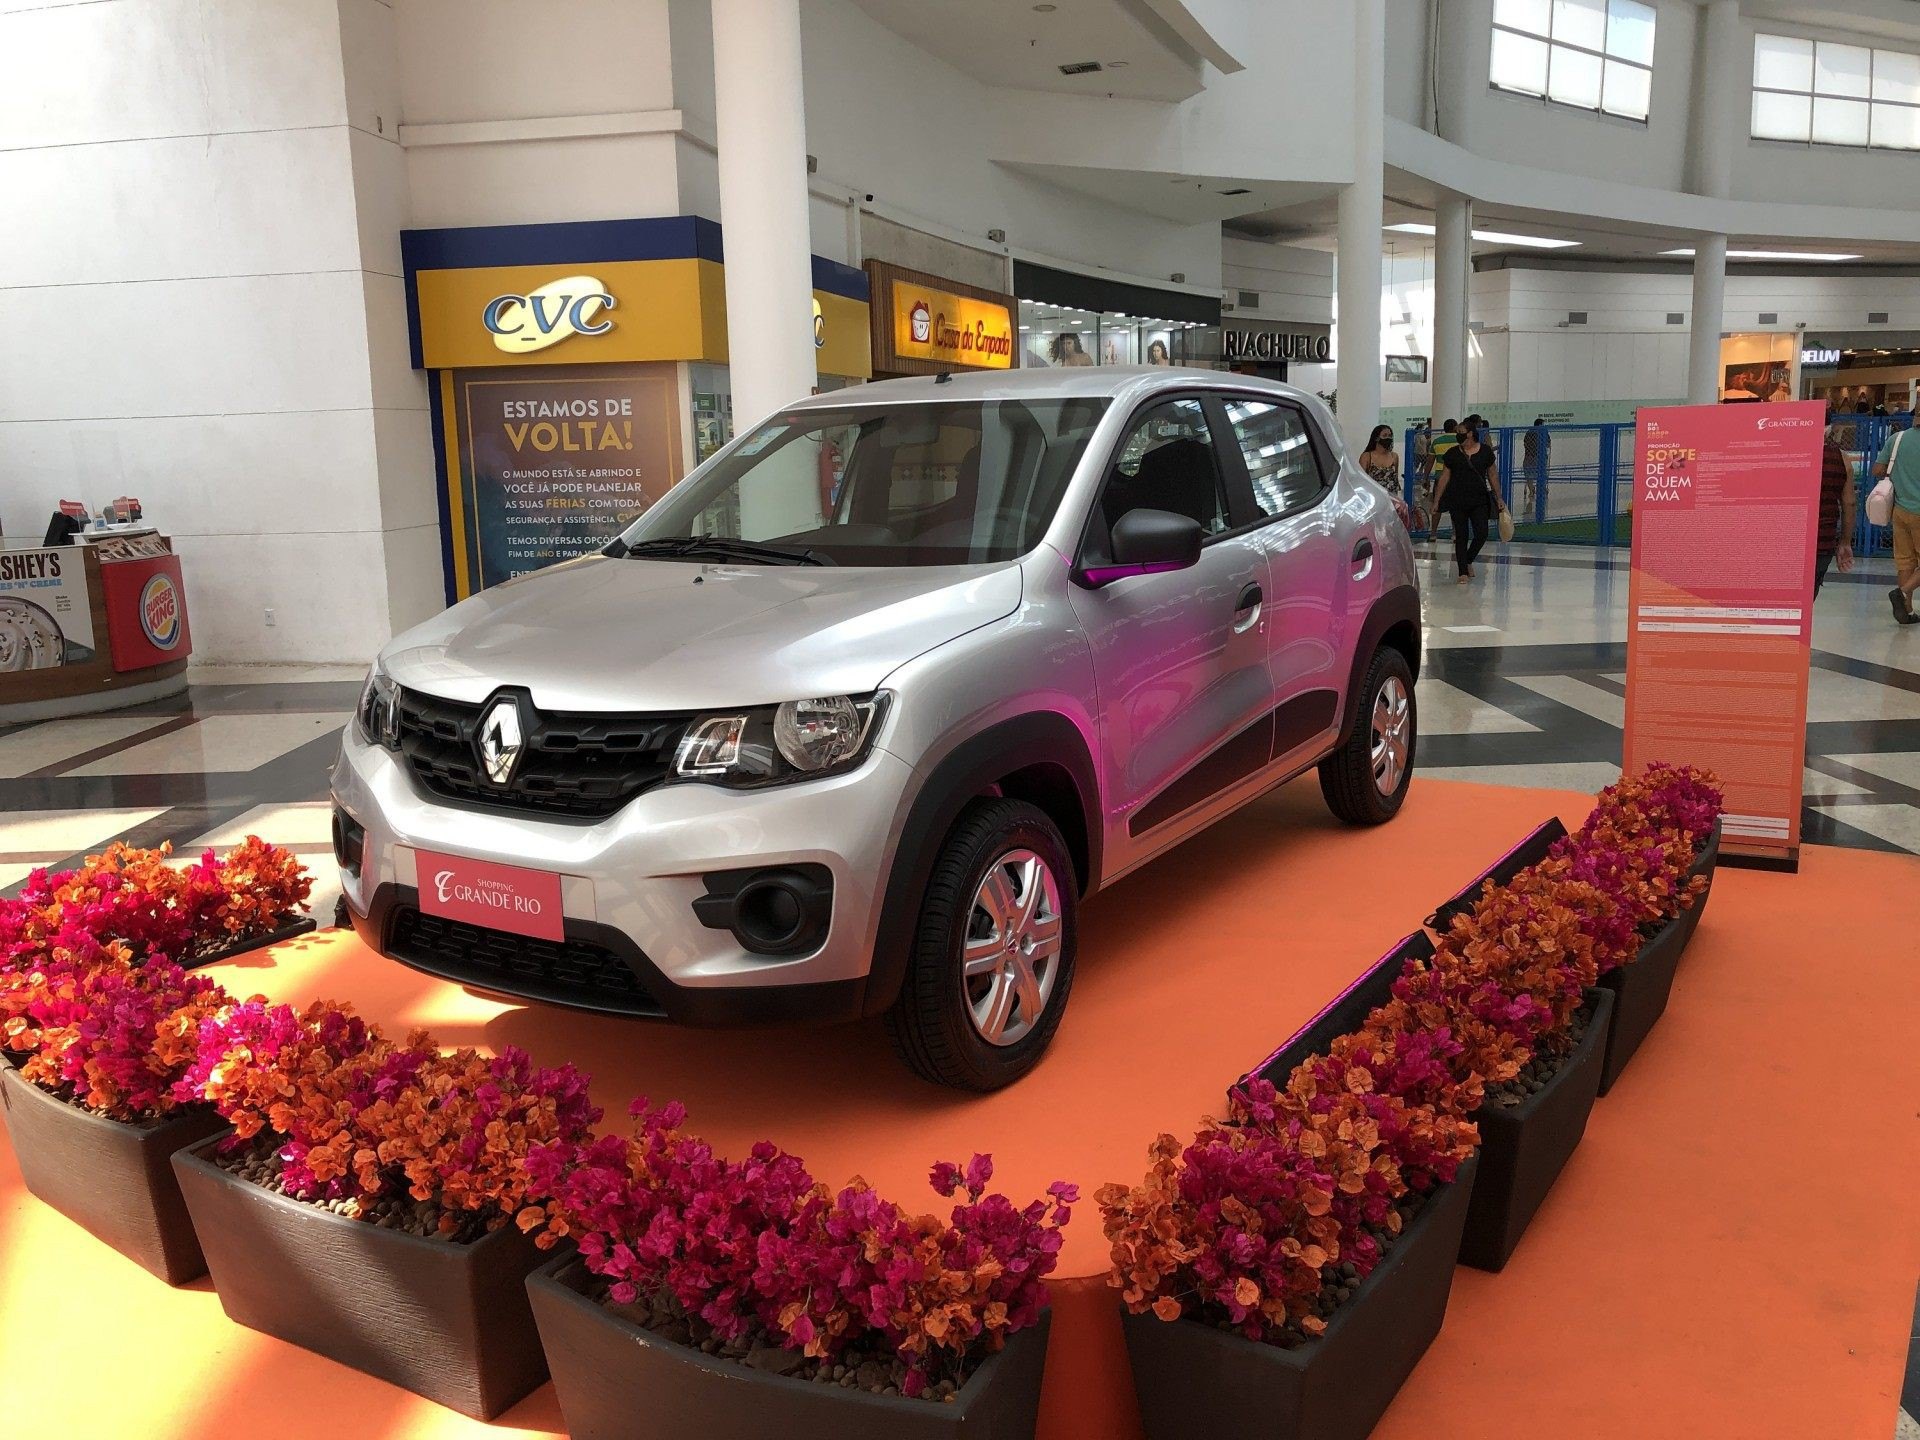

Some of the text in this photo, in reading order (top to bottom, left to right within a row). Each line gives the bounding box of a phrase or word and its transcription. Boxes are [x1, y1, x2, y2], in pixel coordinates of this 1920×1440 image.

[482, 293, 614, 335] CVC
[935, 313, 1010, 360] Casa da Empada
[1223, 330, 1331, 359] RIACHUELO
[503, 399, 633, 418] ESTAMOS DE
[1768, 419, 1814, 428] GRANDE RIO
[503, 420, 633, 452] VOLTA!
[502, 468, 642, 479] O MUNDO ESTÁ SE ABRINDO E
[1646, 463, 1665, 475] DE
[503, 481, 642, 494] VOCÊ JÁ PODE PLANEJAR
[1645, 476, 1692, 488] QUEM
[505, 496, 641, 509] AS SUAS FÉRIAS COM TODA
[1645, 490, 1681, 501] AMA
[506, 510, 643, 526] SEGURANÇA E ASSISTÊNCIA CV
[507, 535, 618, 546] TEMOS DIVERSAS OPÇÕE
[523, 550, 535, 558] DE
[536, 550, 554, 558] ANO
[556, 550, 561, 558] E
[562, 550, 583, 558] PARA
[0, 552, 61, 580] SHEY'S
[146, 587, 173, 617] BURGER
[149, 598, 175, 634] KING
[477, 878, 514, 893] SHOPPING
[454, 884, 541, 915] GRANDE RIO
